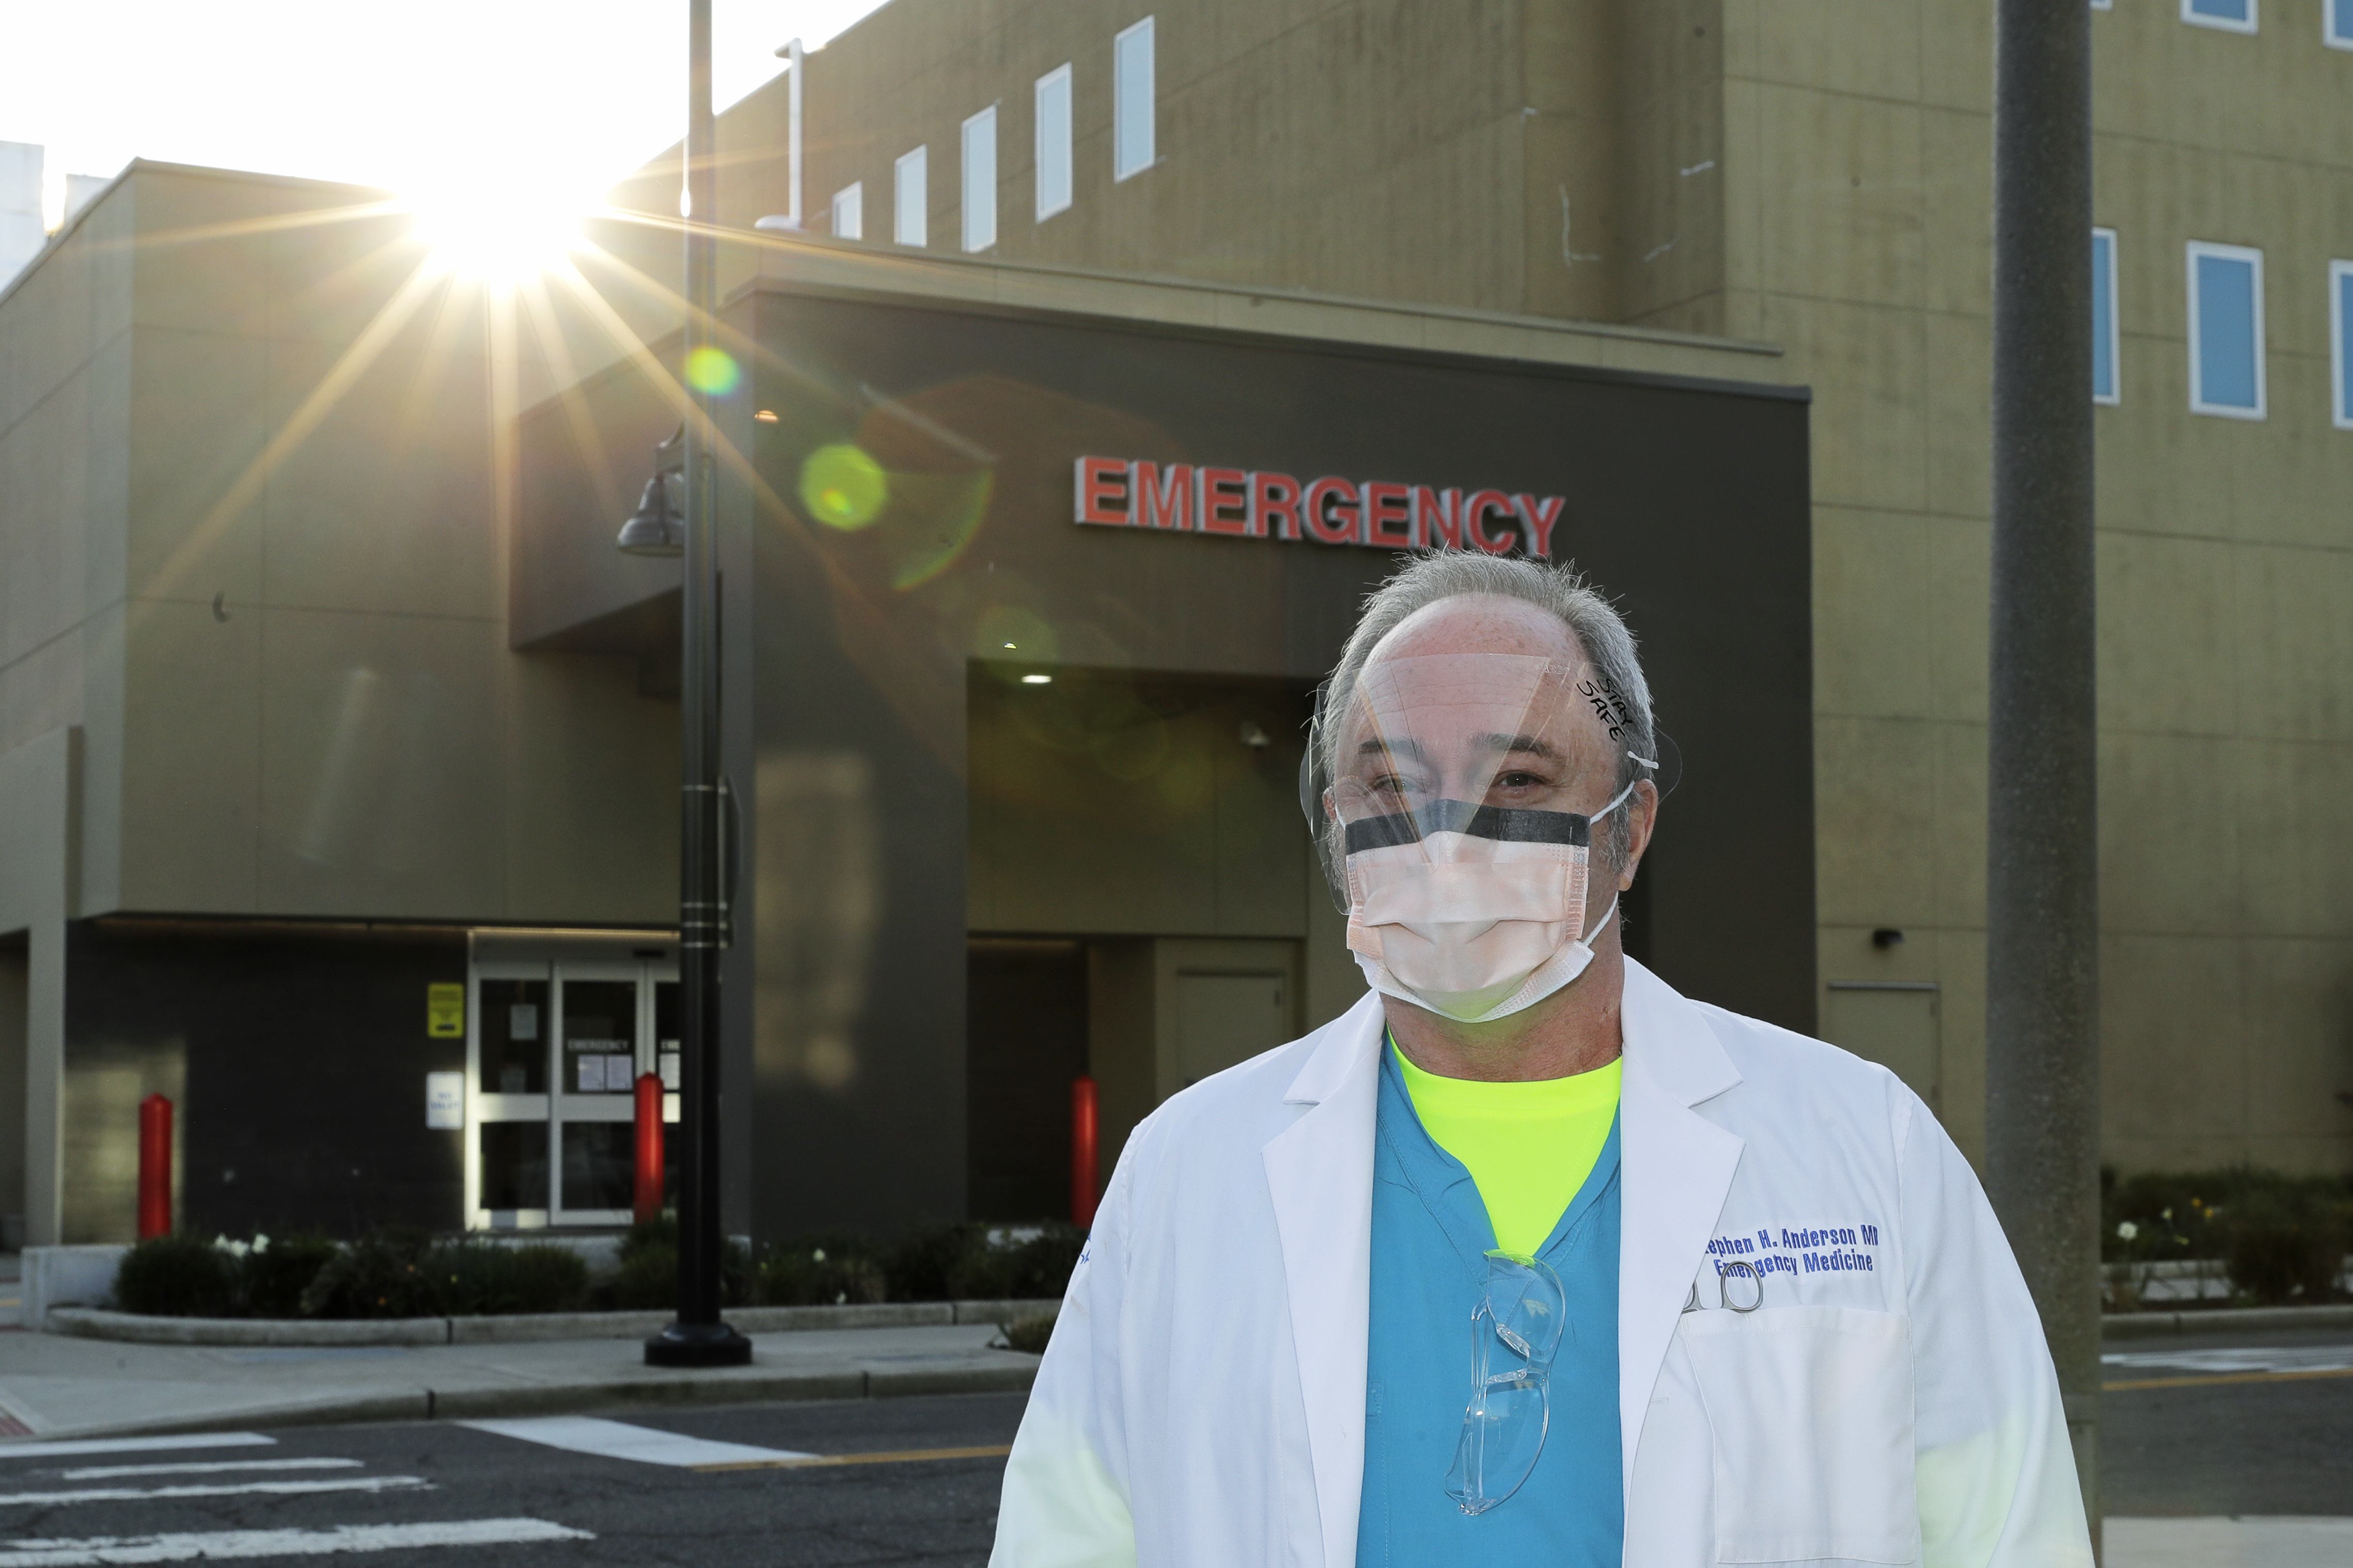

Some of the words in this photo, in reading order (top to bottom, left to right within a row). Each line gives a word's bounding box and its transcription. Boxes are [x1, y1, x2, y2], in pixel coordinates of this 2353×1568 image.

[1074, 456, 1565, 558] EMERGENCY
[1576, 680, 1625, 742] SAFE
[1596, 678, 1633, 725] STAY
[1705, 1236, 1754, 1257] ephen
[1758, 1229, 1778, 1249] H.
[1782, 1228, 1857, 1249] Anderson
[1803, 1248, 1873, 1273] Medicine
